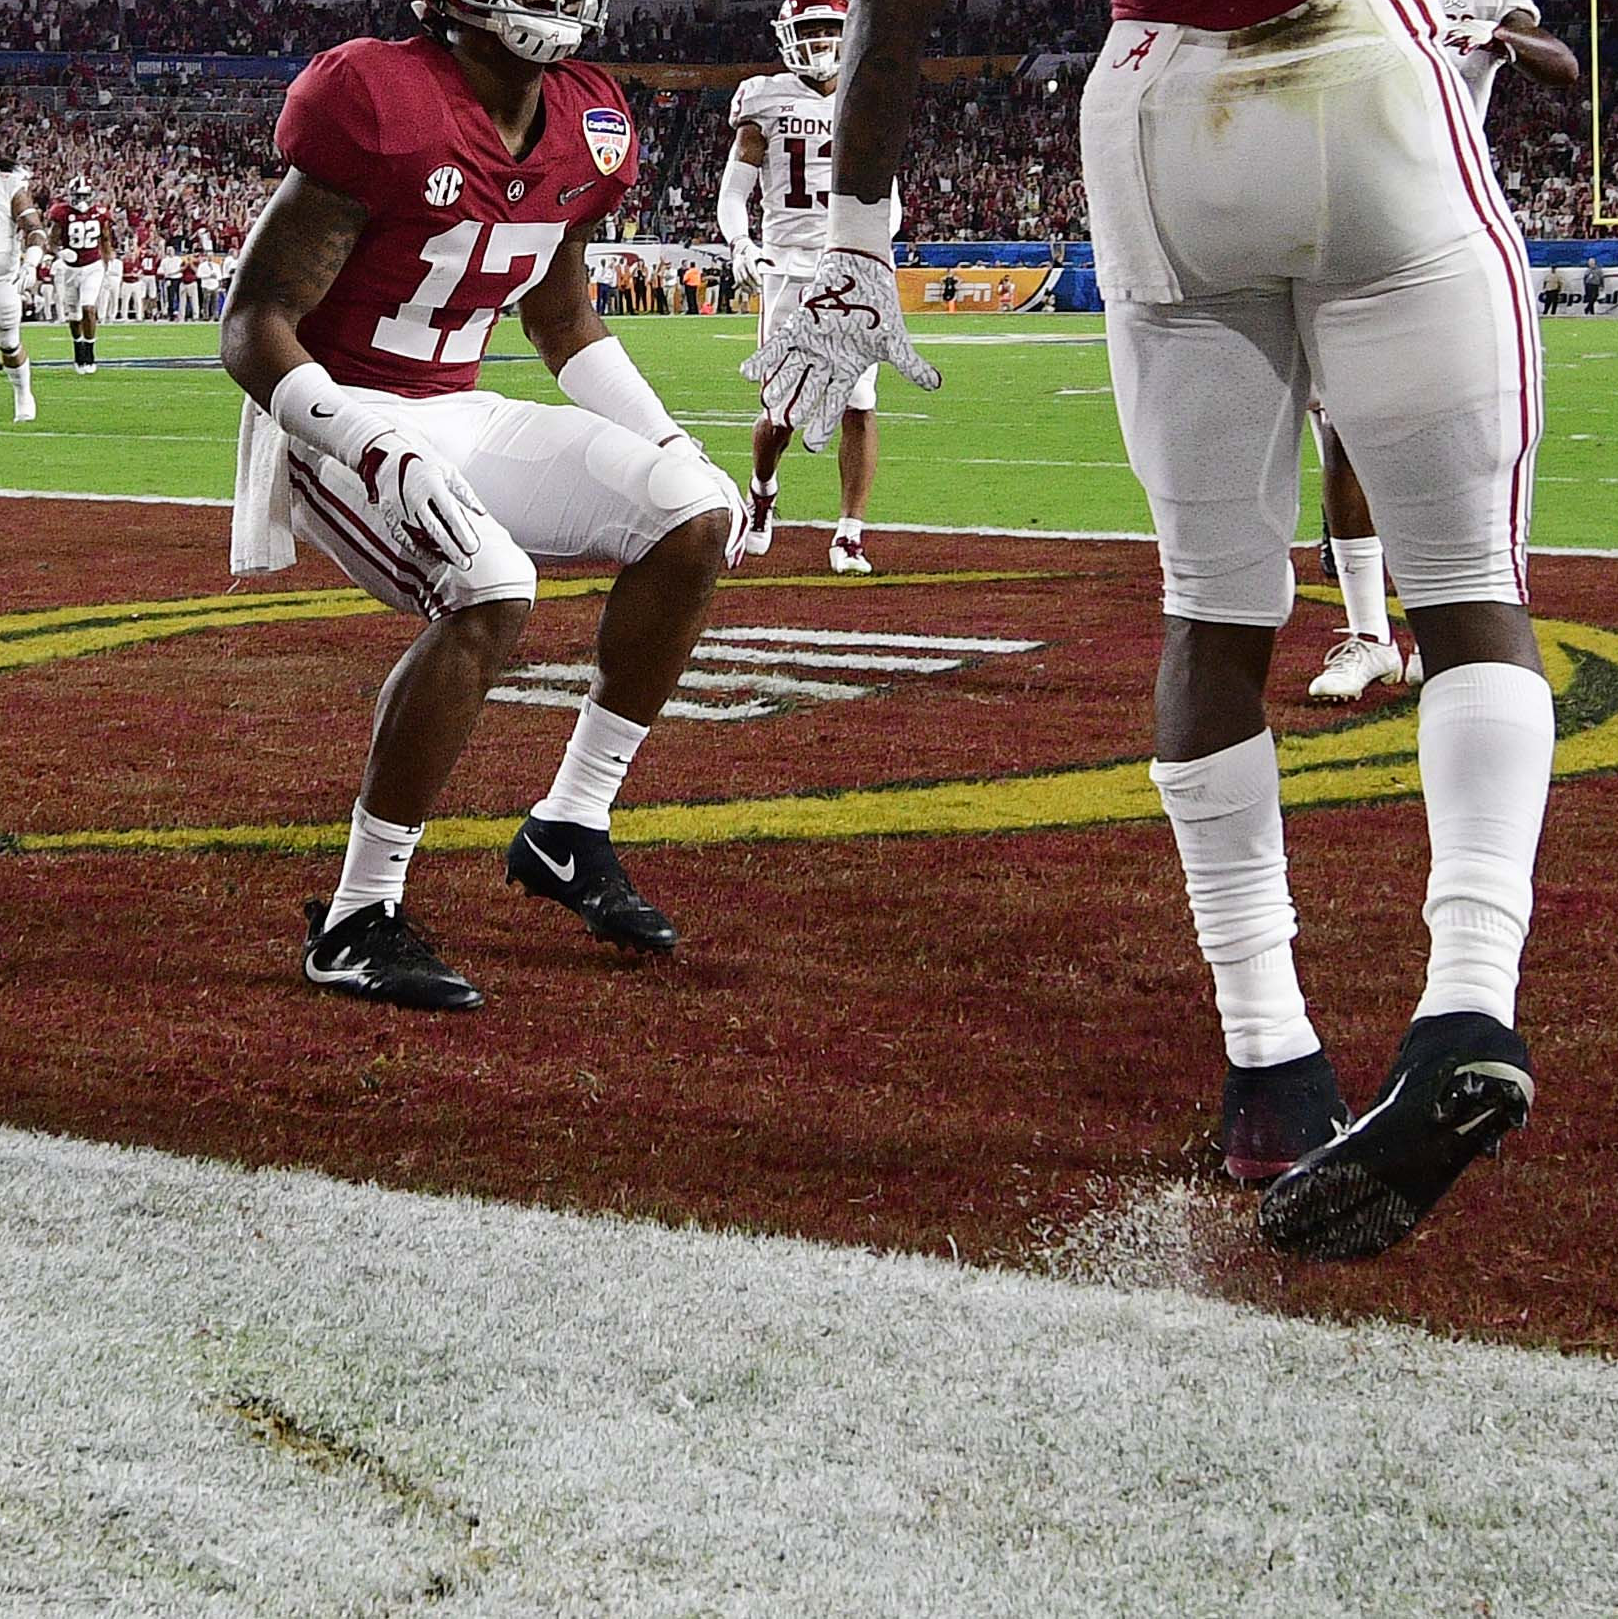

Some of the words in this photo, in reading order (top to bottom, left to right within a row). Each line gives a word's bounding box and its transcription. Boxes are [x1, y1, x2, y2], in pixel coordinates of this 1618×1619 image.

[778, 116, 833, 136] SOON
[424, 166, 465, 207] SEC
[68, 220, 101, 249] 82
[371, 219, 570, 364] 17
[924, 282, 993, 303] EPN
